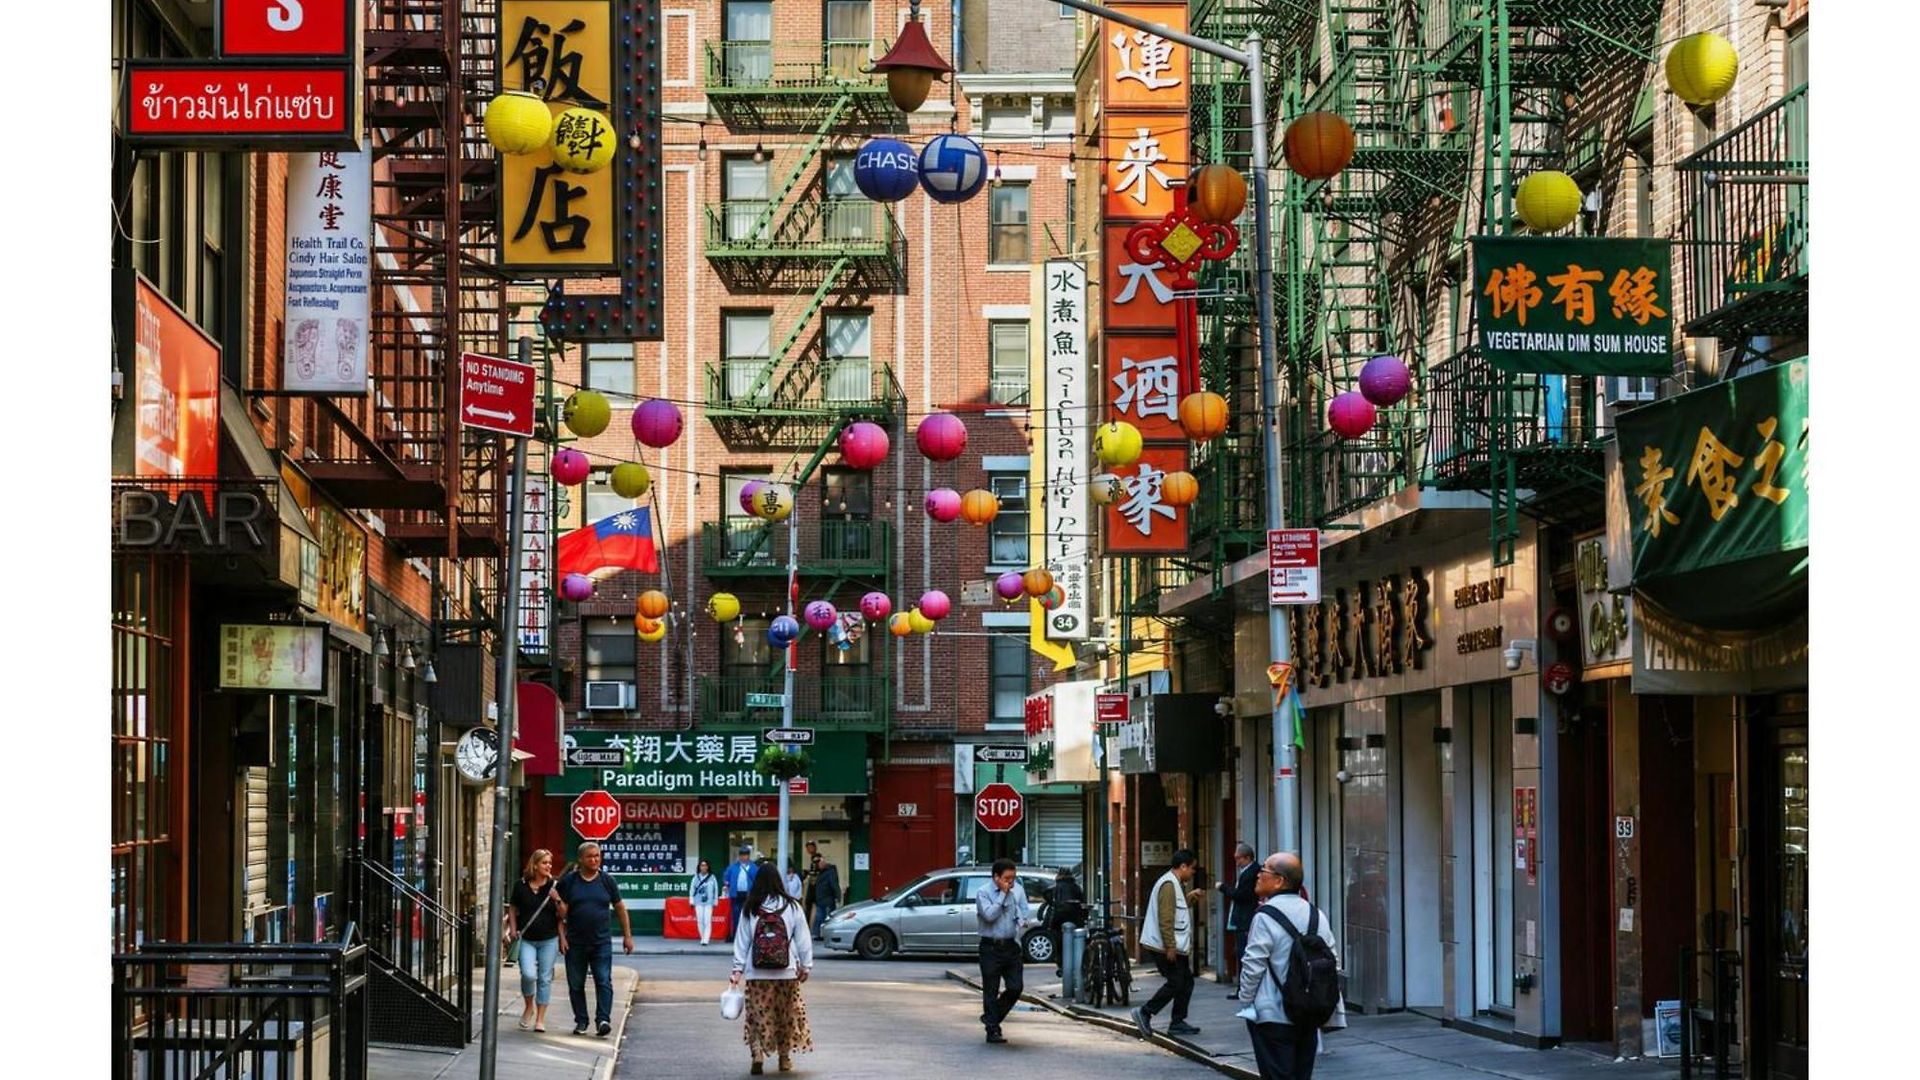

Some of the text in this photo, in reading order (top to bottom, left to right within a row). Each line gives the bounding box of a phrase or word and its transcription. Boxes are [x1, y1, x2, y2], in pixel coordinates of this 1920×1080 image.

[143, 83, 333, 119] ข้าวมันไก่แซ่บ
[504, 16, 610, 254] 飯店
[857, 151, 918, 172] CHASE
[292, 237, 323, 249] Health
[326, 237, 347, 249] Trail
[289, 251, 316, 266] Cindy
[320, 252, 339, 264] Hair
[1484, 262, 1668, 327] 佛有緣
[1051, 270, 1080, 356] 水煮魚
[1487, 331, 1667, 353] VEGETARIAN DIM SUM HOUSE
[466, 361, 524, 384] NO STANDING
[466, 378, 504, 395] Anytime
[1635, 416, 1809, 538] 素食之
[120, 491, 263, 546] BAR
[1056, 616, 1073, 629] 34
[603, 770, 693, 790] Paradigm
[700, 770, 763, 787] Health
[575, 807, 617, 825] STOP
[625, 801, 768, 819] GRAND OPENING
[978, 799, 1019, 816] STOP
[1617, 820, 1633, 836] 39
